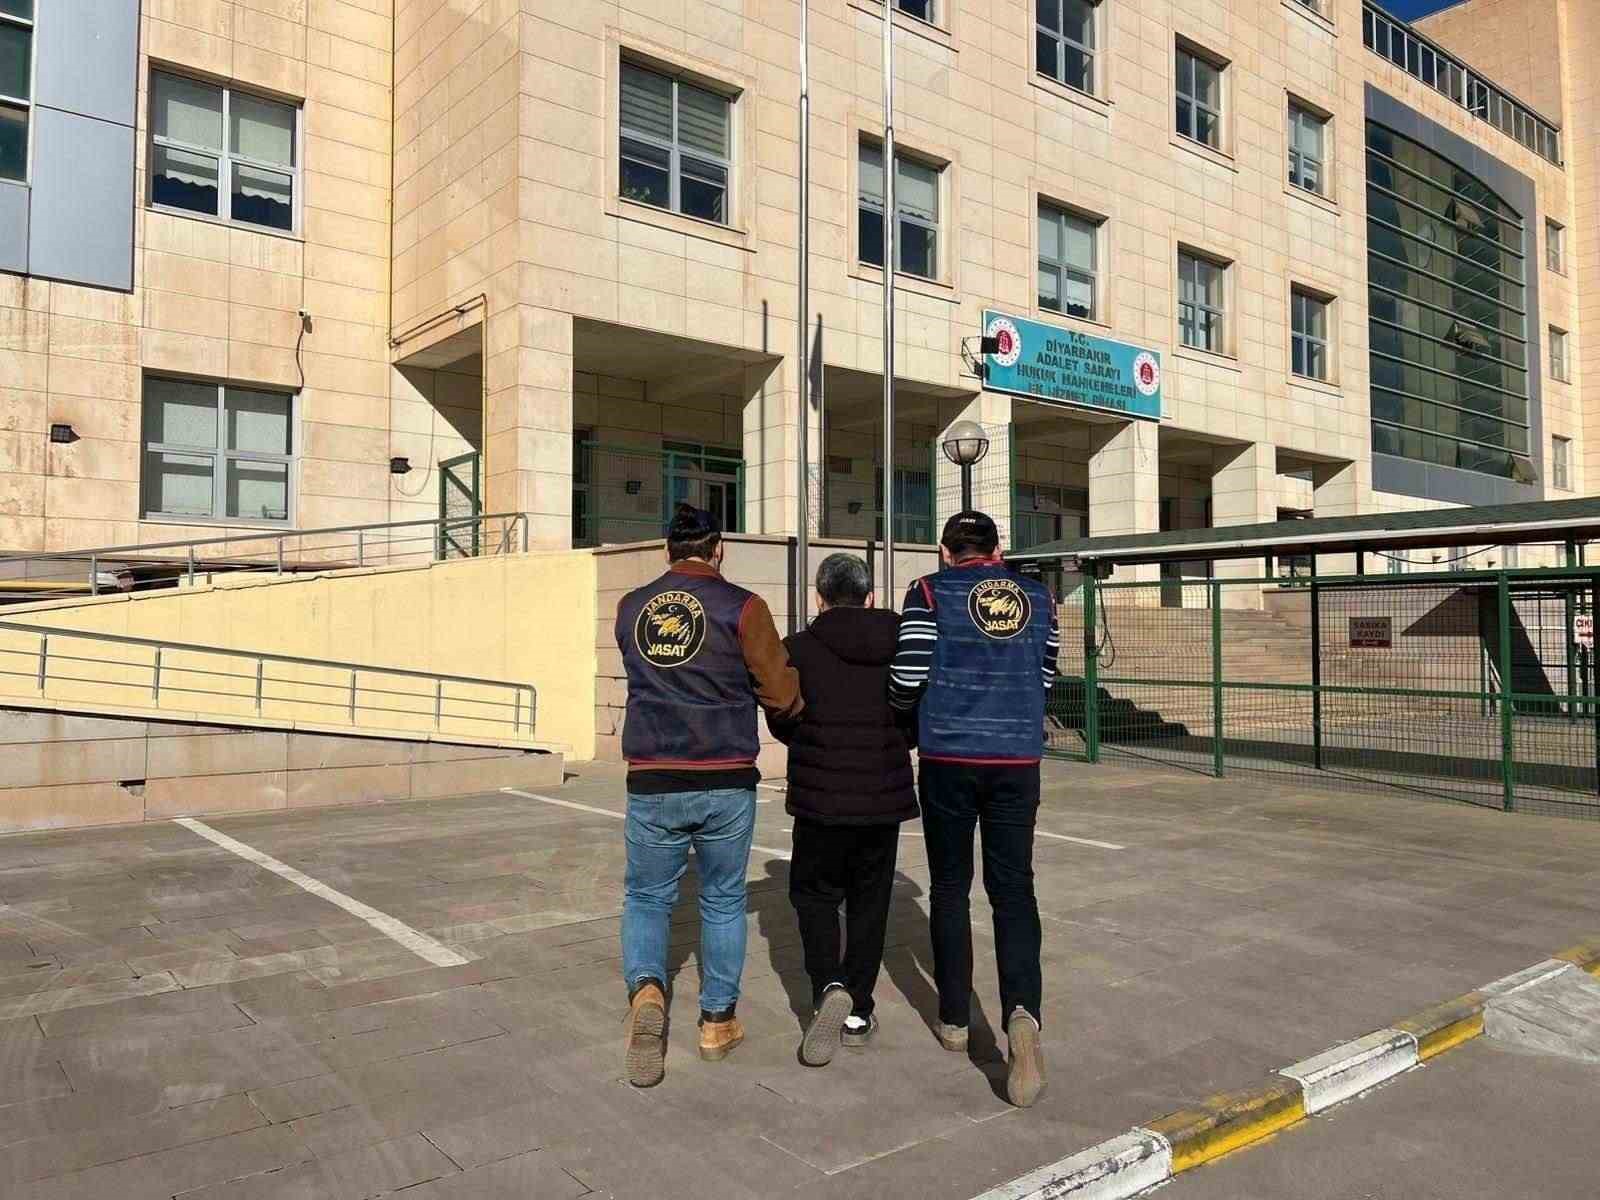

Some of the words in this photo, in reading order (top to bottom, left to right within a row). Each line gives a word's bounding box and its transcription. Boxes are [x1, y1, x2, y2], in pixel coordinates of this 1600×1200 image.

[1046, 339, 1112, 366] DİYARBAKIR
[1017, 364, 1056, 383] HUKUK
[1036, 352, 1079, 371] ADALET
[1084, 363, 1121, 380] SARAYI
[972, 581, 1020, 597] JANDARMA
[646, 594, 701, 618] JANDARMA
[985, 620, 1019, 631] JASAT
[647, 643, 687, 657] JASAT
